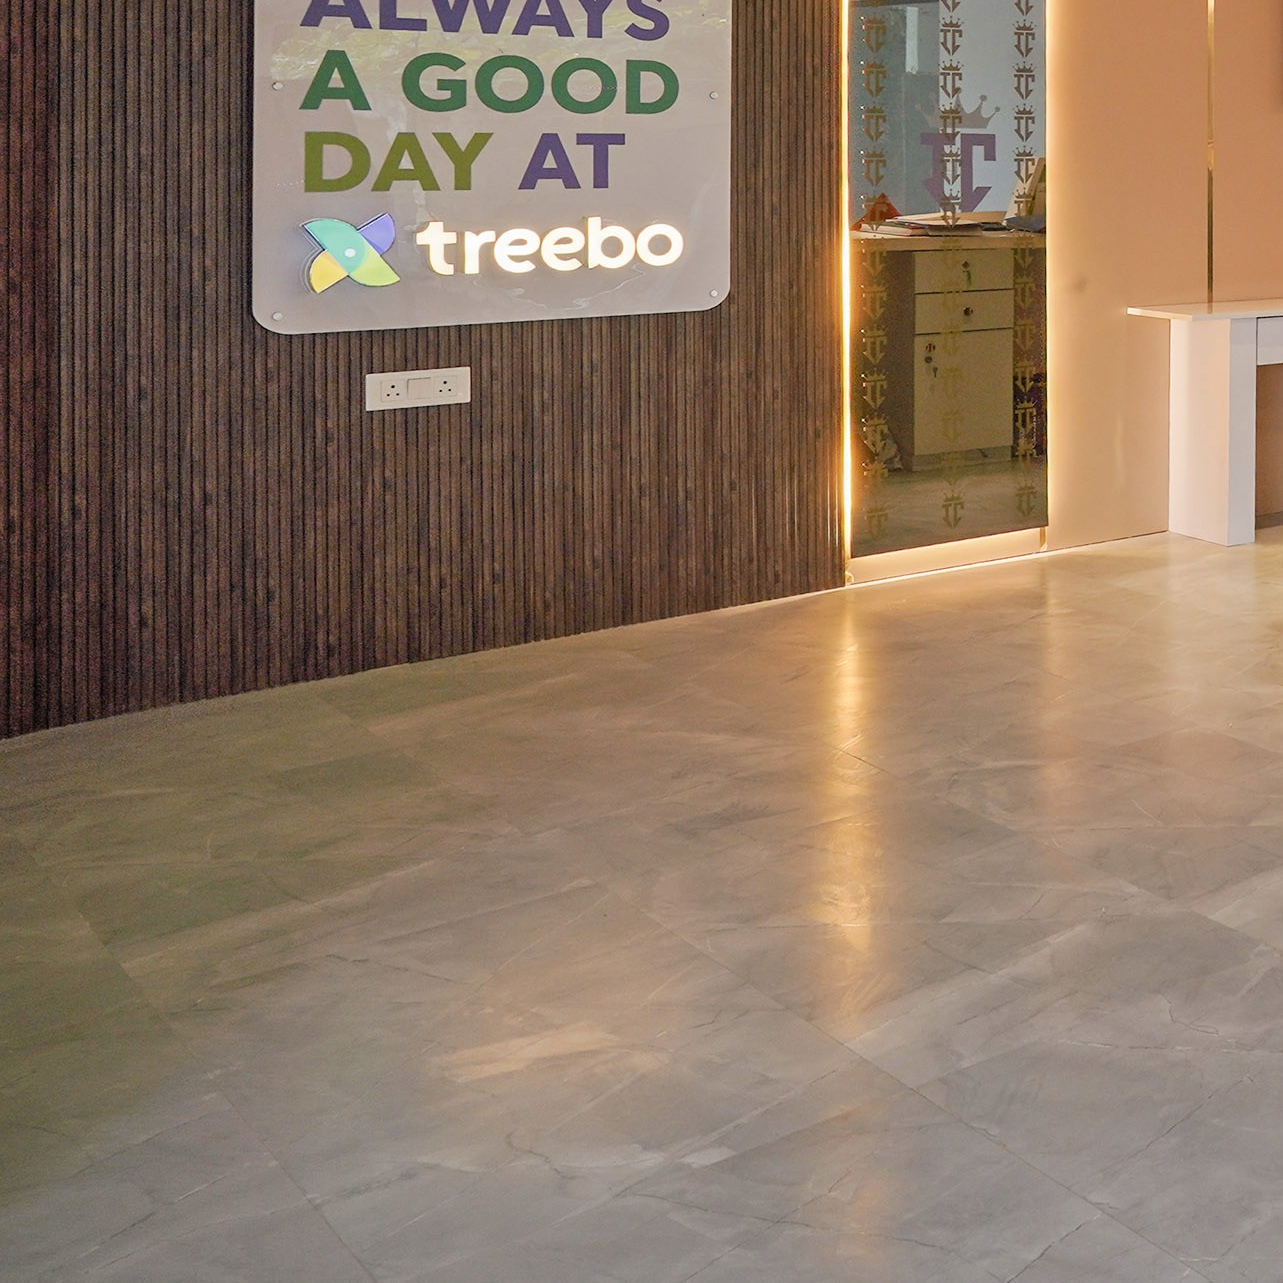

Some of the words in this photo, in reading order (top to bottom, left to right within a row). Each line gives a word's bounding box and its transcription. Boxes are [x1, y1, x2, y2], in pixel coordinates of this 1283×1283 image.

[299, 49, 372, 111] A
[401, 52, 680, 114] GOOD
[303, 131, 494, 193] DAY
[518, 133, 626, 190] AT
[415, 216, 685, 276] treebo
